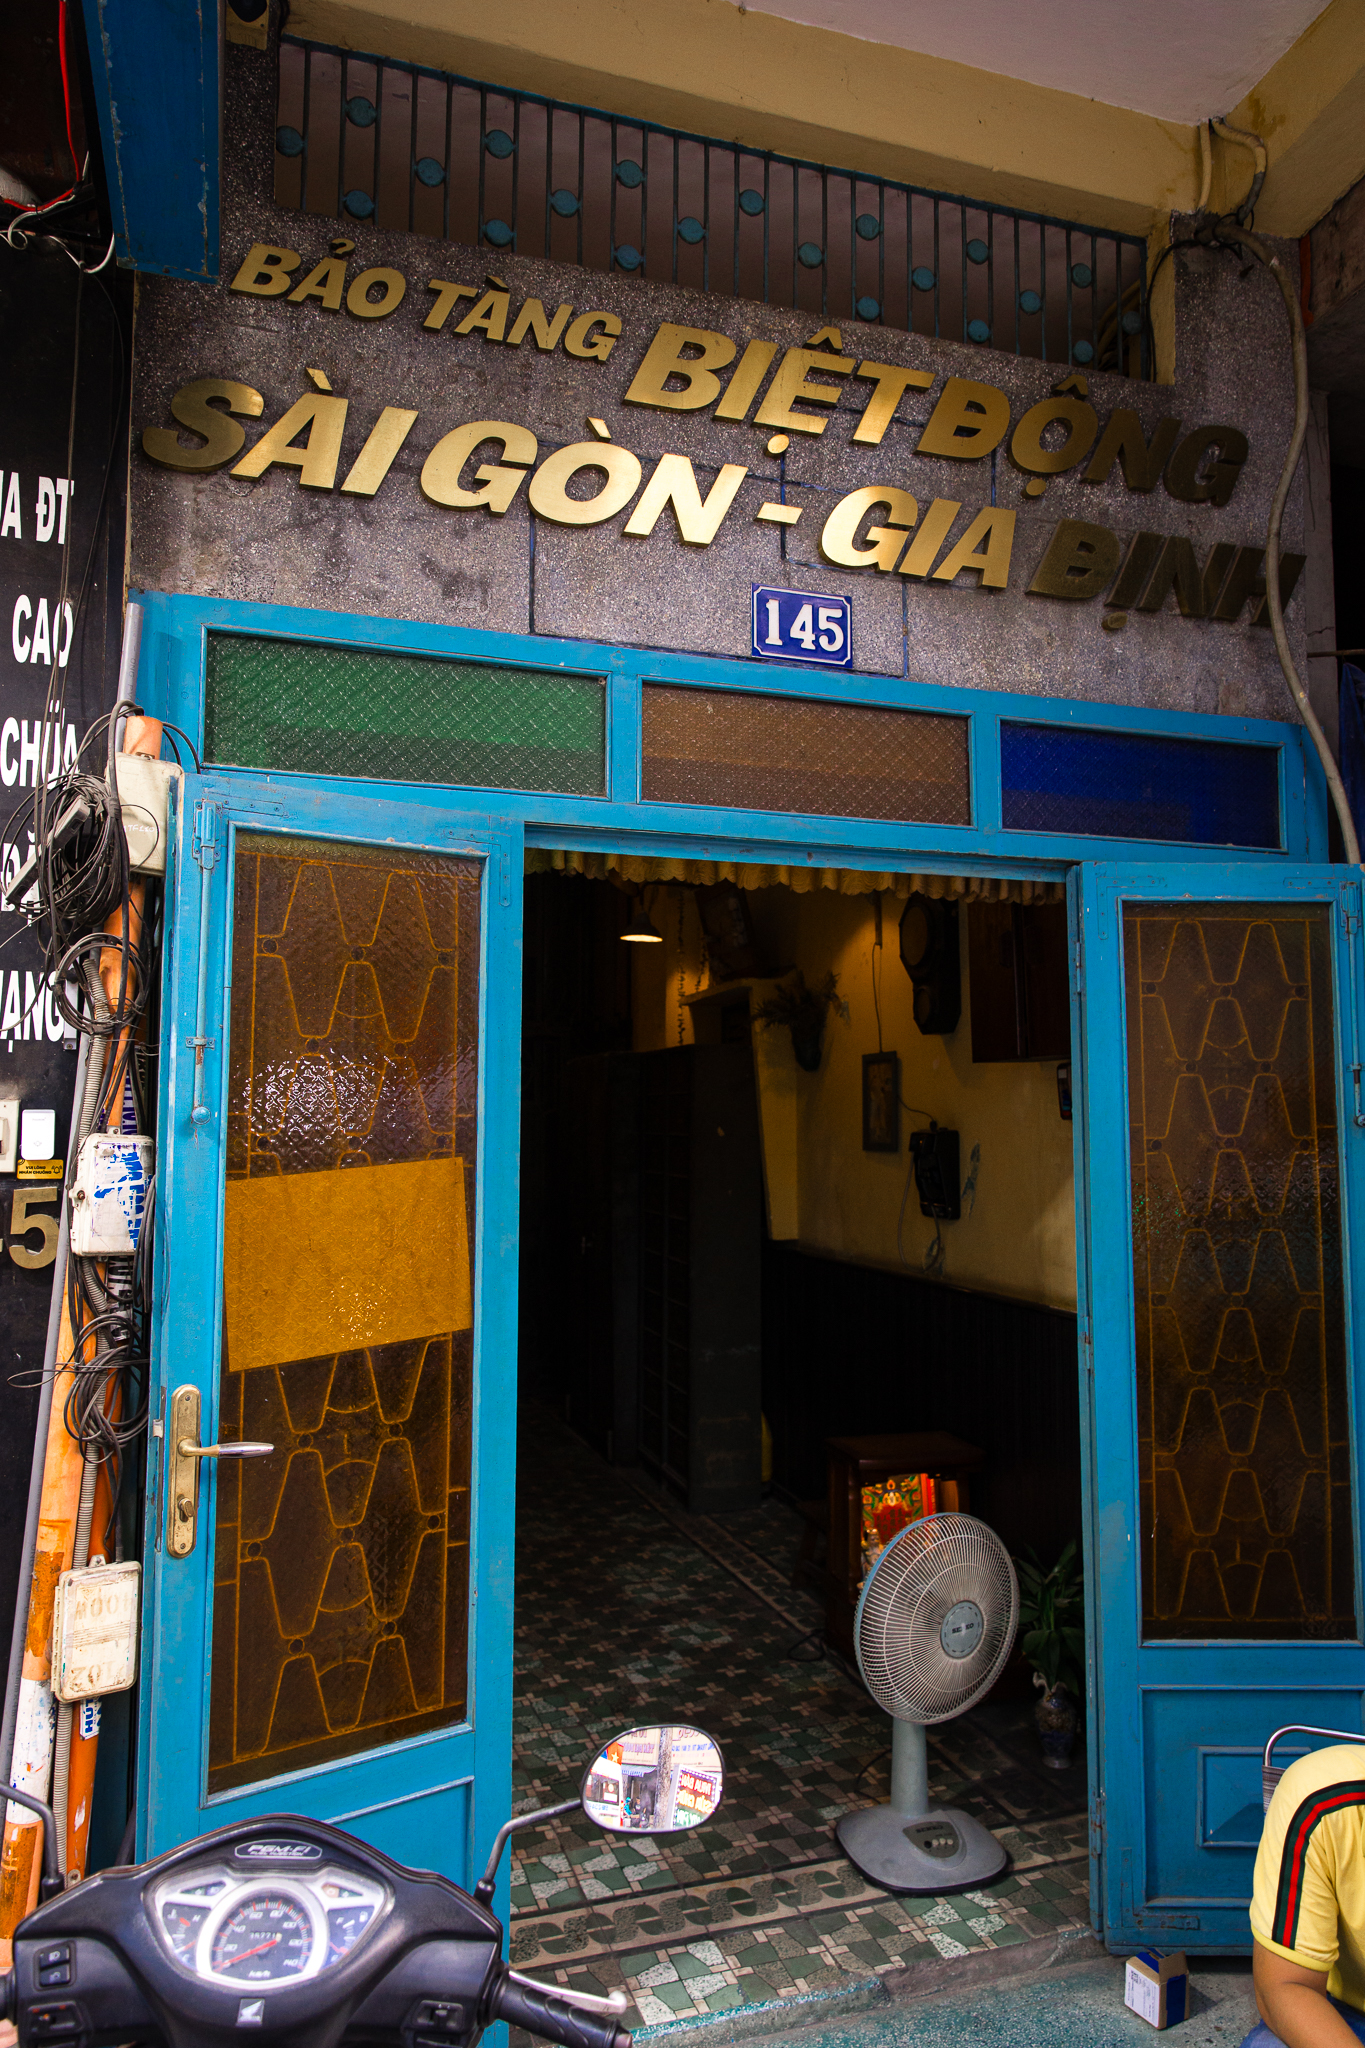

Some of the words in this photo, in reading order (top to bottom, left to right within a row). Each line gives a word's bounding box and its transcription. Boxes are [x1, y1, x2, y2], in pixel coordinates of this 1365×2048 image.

[230, 238, 407, 321] BẢO
[423, 275, 622, 361] TÀNG
[623, 322, 935, 457] BIỆT
[914, 374, 1250, 507] ĐỘNG
[0, 470, 22, 540] A
[36, 476, 75, 545] ĐT
[142, 367, 420, 496] SÀI
[420, 416, 748, 548] GÒN
[819, 485, 1017, 590] GIA
[1024, 518, 1307, 631] ĐỊNH
[12, 594, 74, 668] CAO
[765, 598, 844, 652] 145
[0, 969, 65, 1053] ẠNG
